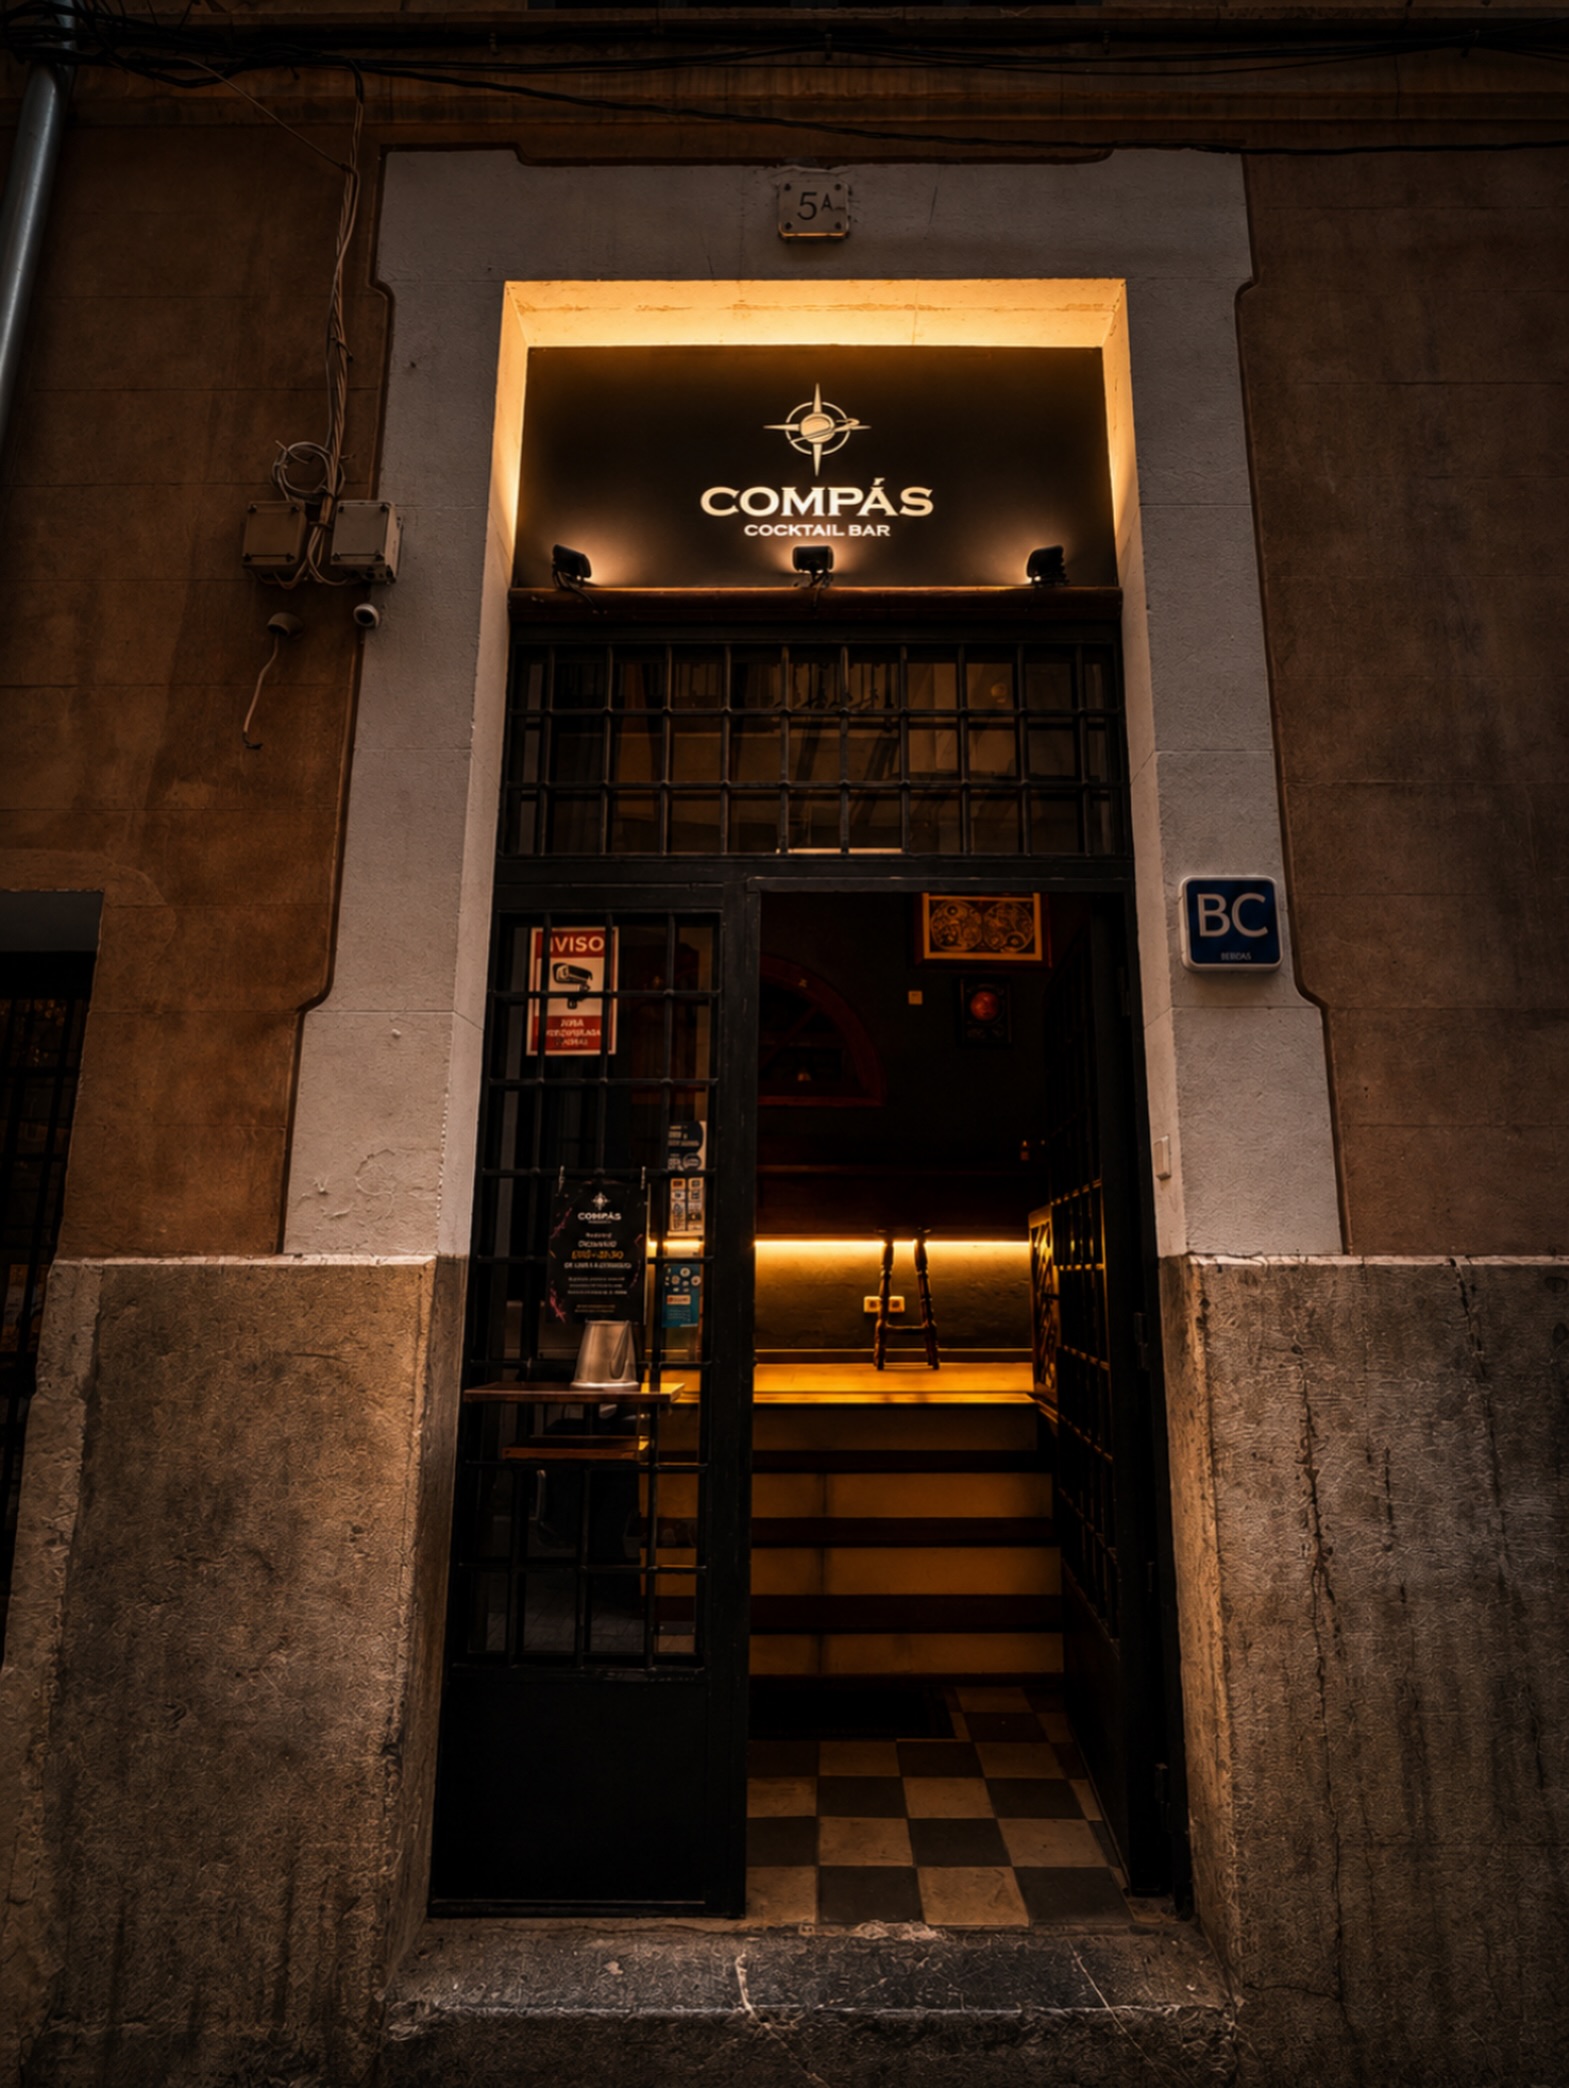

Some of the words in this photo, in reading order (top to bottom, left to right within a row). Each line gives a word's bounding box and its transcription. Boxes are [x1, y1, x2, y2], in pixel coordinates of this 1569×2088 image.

[700, 477, 935, 517] COMPÁS
[744, 524, 845, 537] COCKTAIL
[848, 524, 892, 537] BAR
[1197, 891, 1269, 939] BC
[549, 935, 605, 952] VISO
[577, 1211, 622, 1221] COMPÁS
